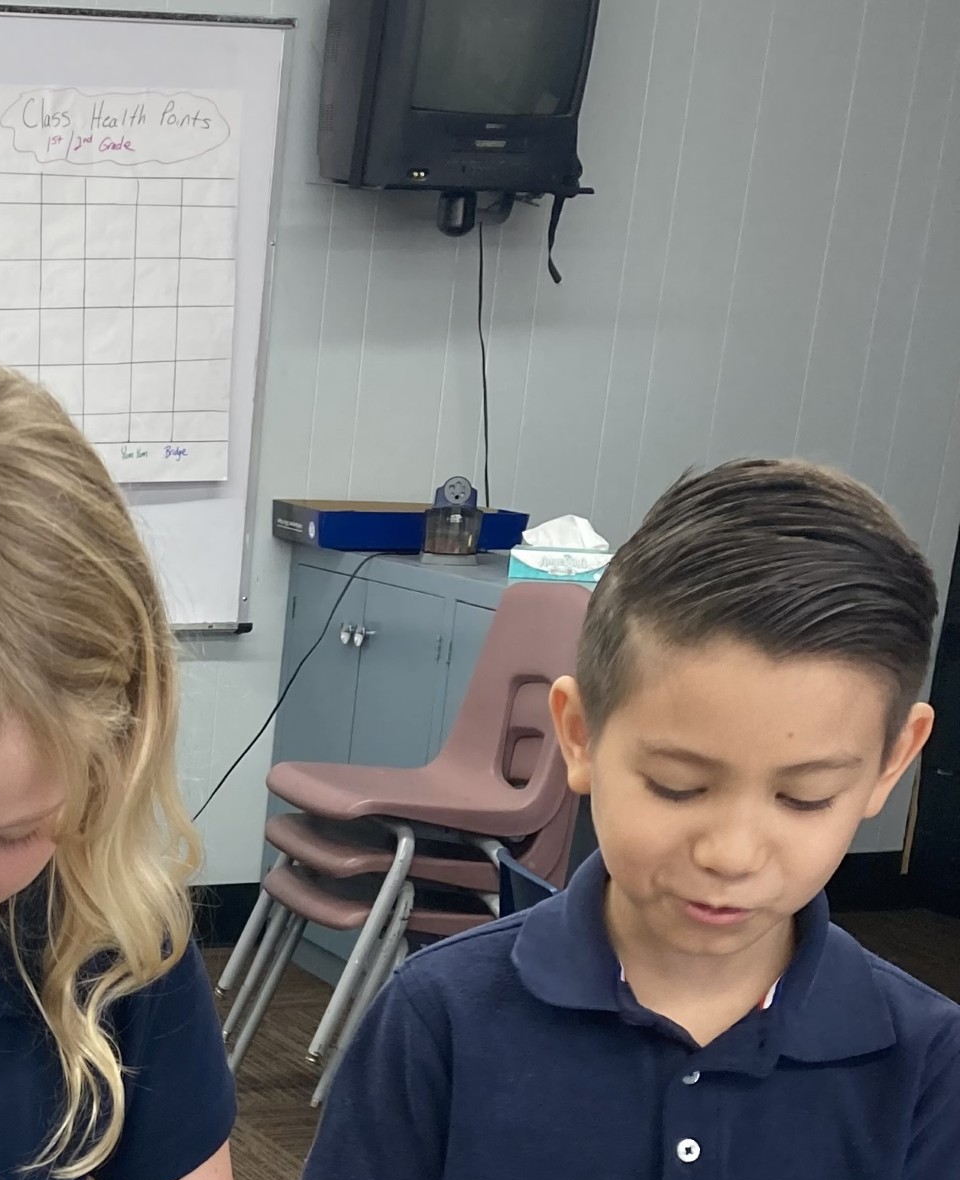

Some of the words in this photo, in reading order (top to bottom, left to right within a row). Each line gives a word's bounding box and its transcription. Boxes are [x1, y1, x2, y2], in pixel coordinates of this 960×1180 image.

[22, 98, 70, 128] Class
[91, 100, 146, 130] Health
[159, 100, 211, 129] Points
[99, 136, 135, 153] Grade
[164, 446, 188, 461] Bridge
